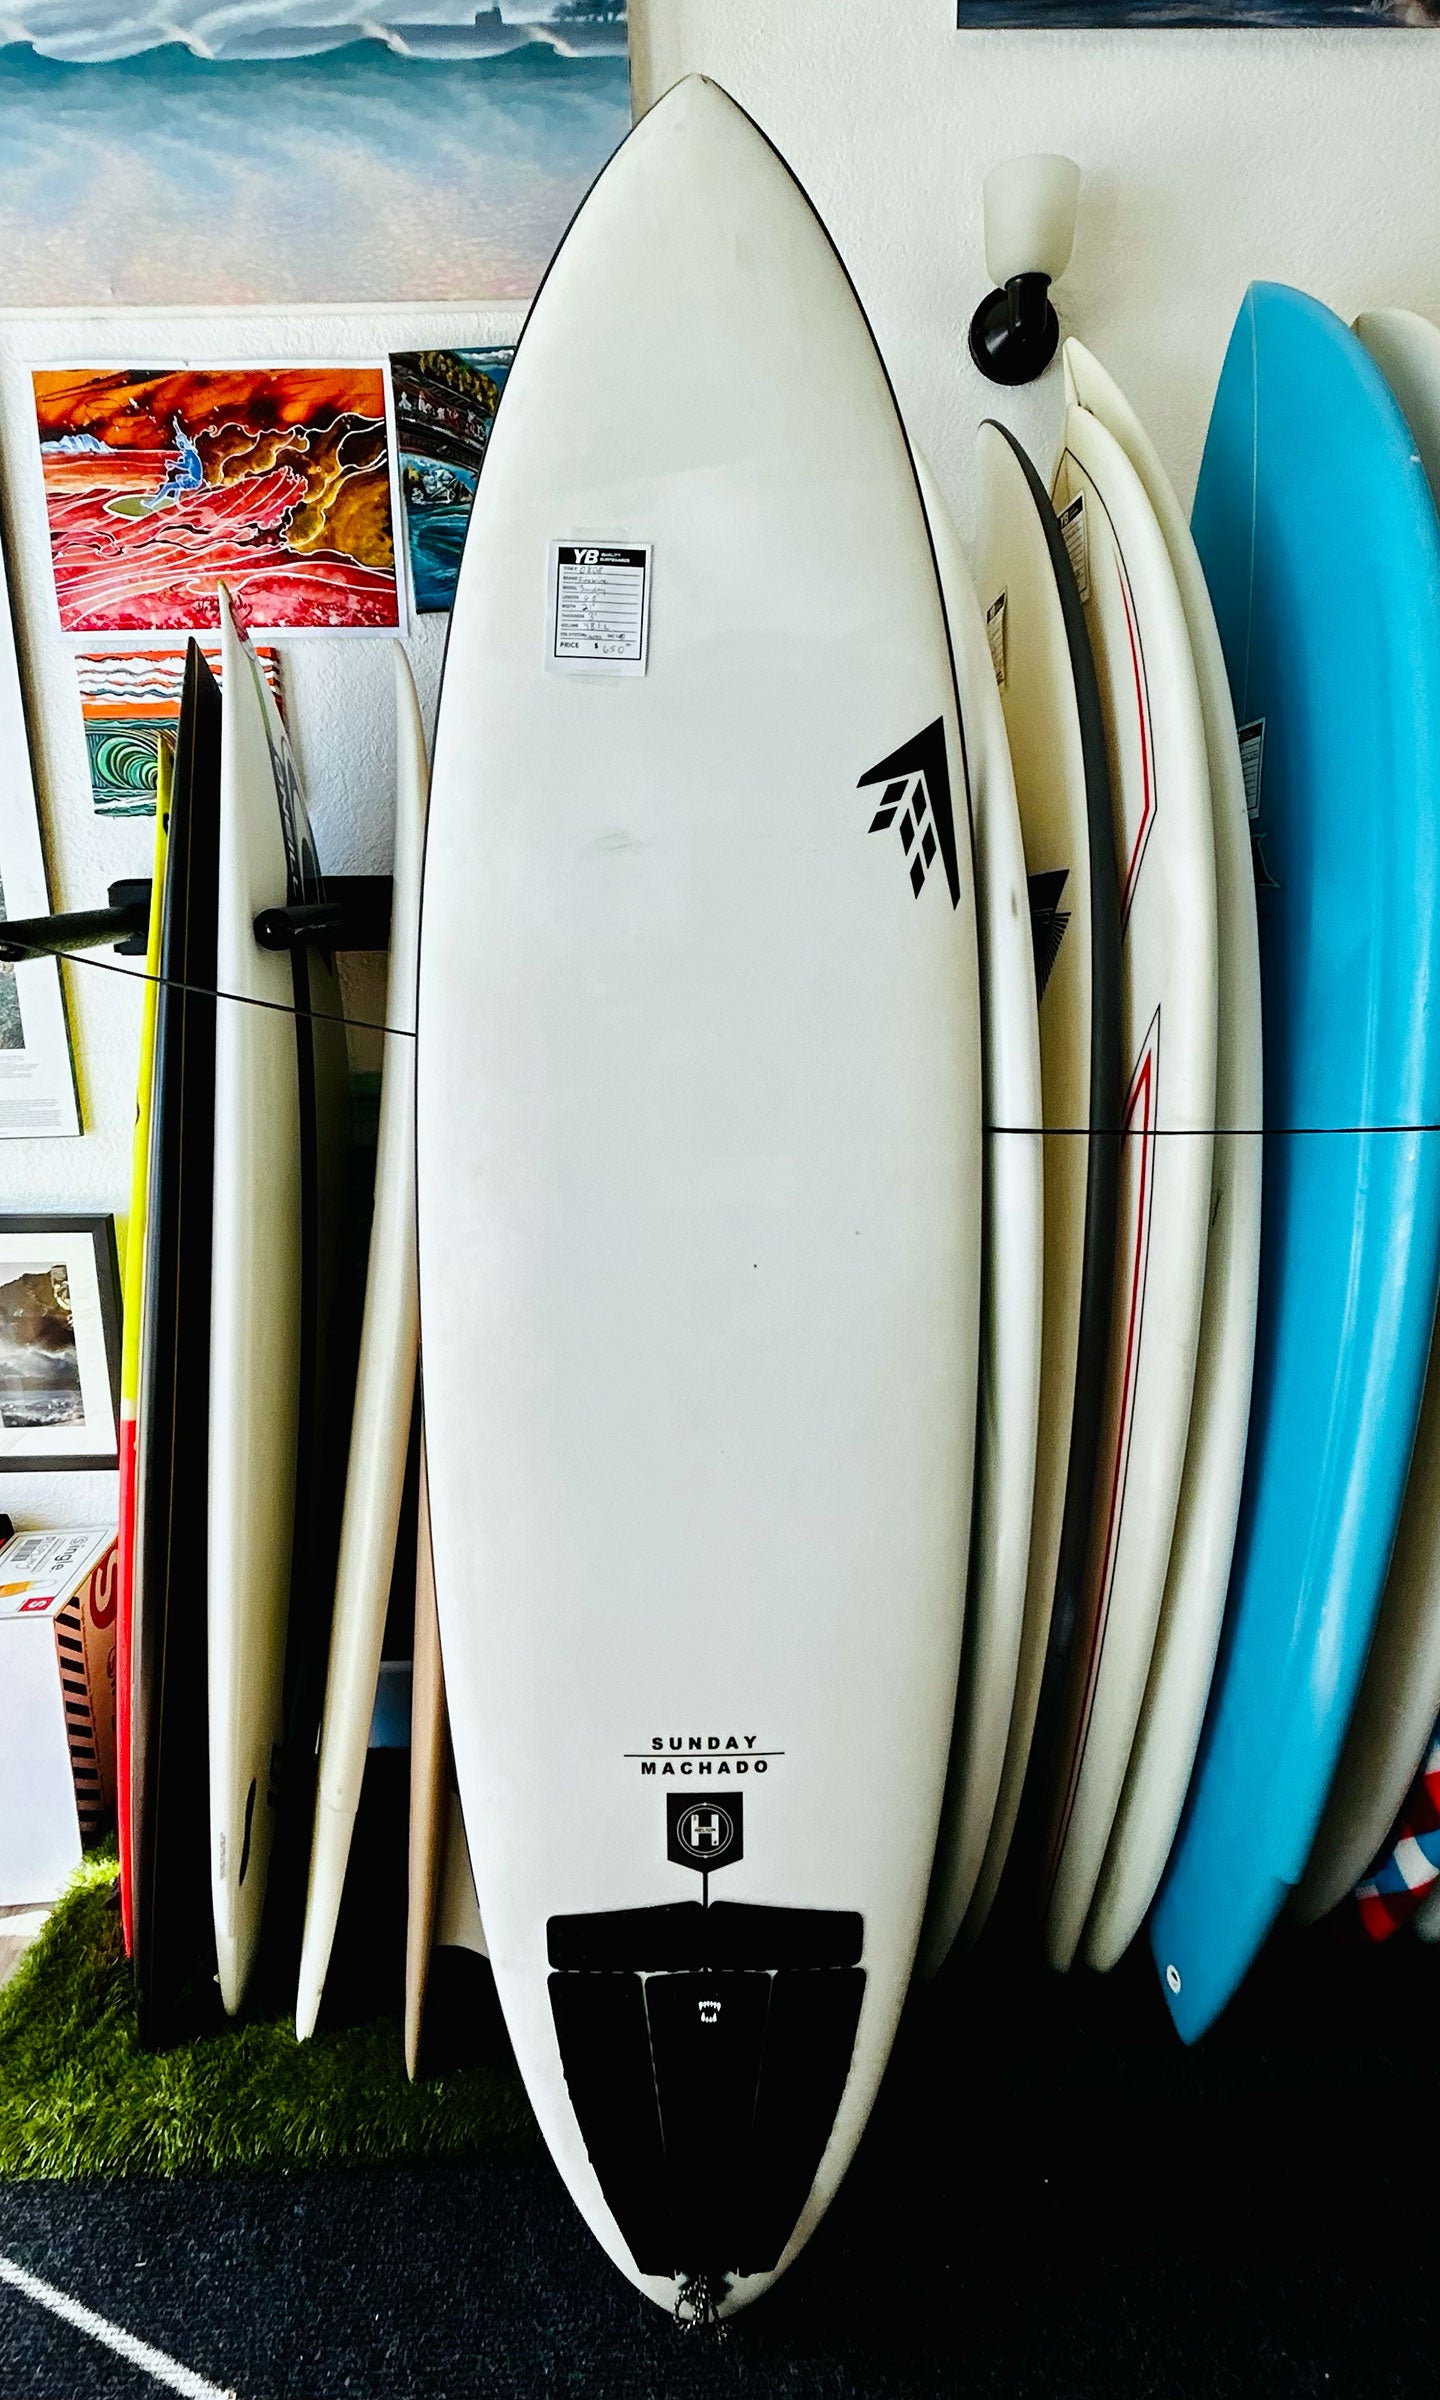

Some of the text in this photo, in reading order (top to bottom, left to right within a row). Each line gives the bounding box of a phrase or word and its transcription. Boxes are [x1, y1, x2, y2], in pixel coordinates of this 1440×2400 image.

[573, 549, 599, 564] YB
[652, 1736, 757, 1750] SUNDAY
[641, 1760, 768, 1775] MACHADO
